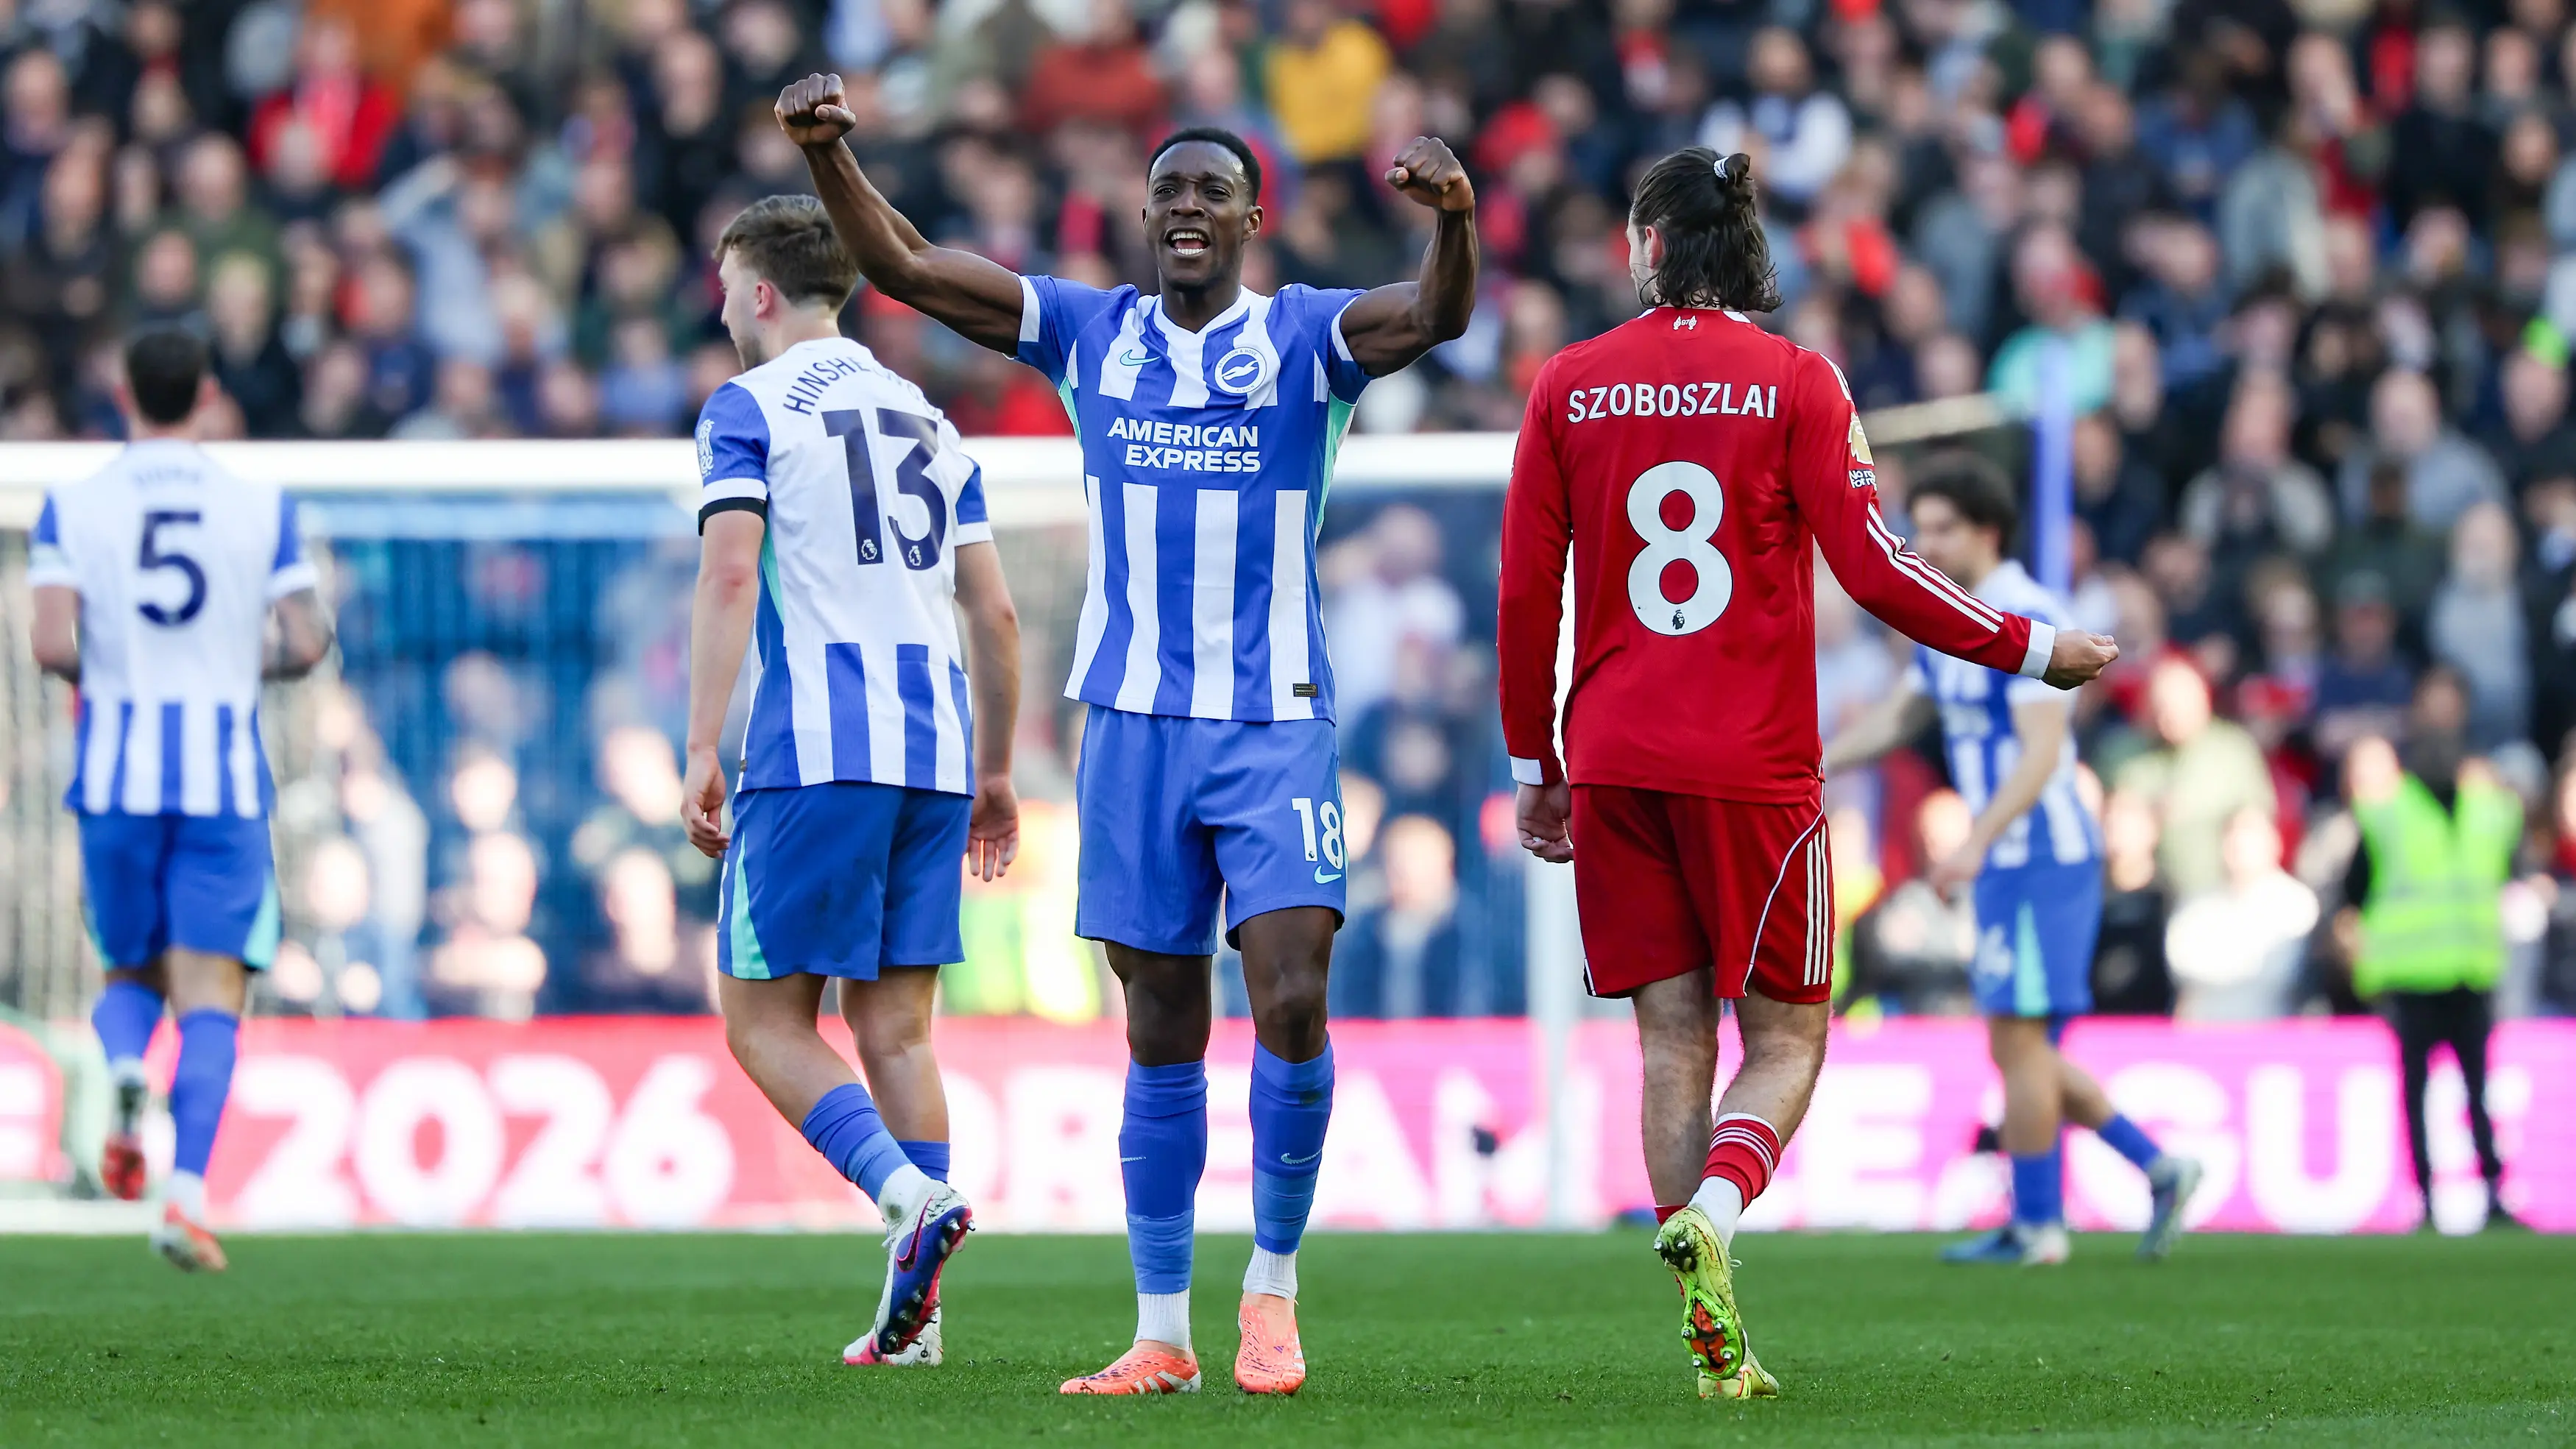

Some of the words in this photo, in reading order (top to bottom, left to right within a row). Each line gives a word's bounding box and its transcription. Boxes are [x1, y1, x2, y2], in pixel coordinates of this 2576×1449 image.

[1218, 350, 1239, 369] BRIGHTON
[1236, 383, 1256, 392] ALBION
[1567, 382, 1777, 423] SZOBOSZLAI
[1107, 417, 1258, 447] AMERICAN
[1125, 444, 1261, 473] EXPRESS
[821, 406, 947, 571] 13
[138, 509, 207, 628] 5
[1627, 461, 1733, 636] 8
[1292, 798, 1342, 870] 18
[234, 1055, 735, 1227] 2026
